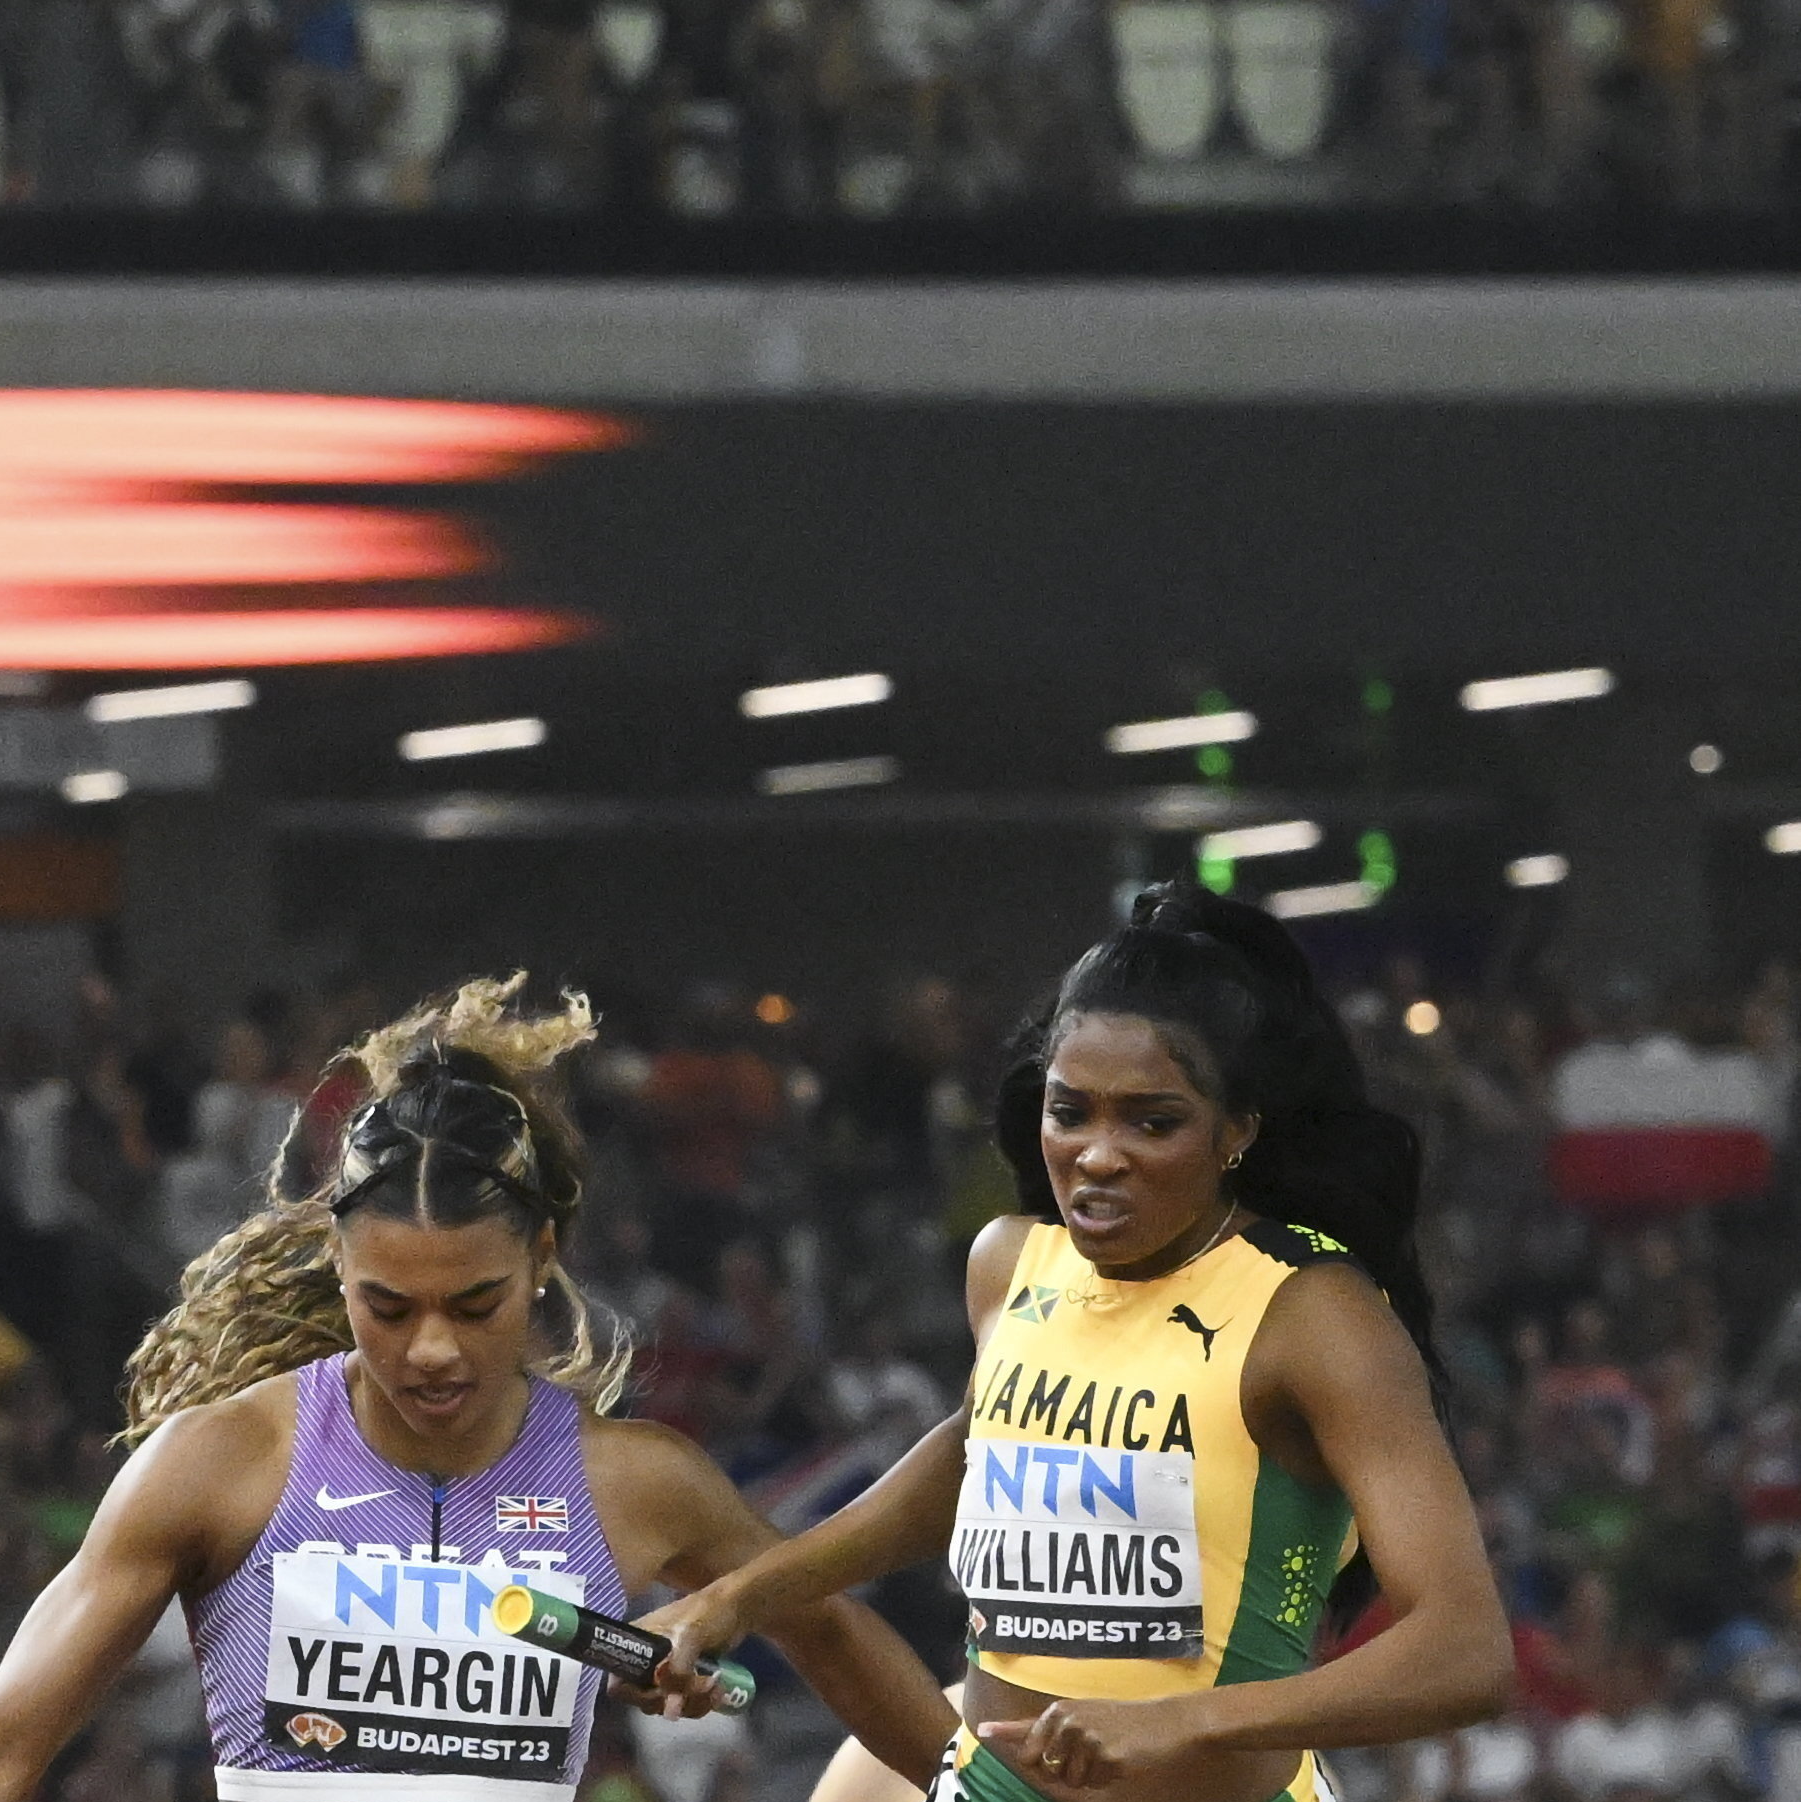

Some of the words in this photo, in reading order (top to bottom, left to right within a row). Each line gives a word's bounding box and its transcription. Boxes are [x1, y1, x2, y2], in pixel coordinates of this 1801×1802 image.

[975, 1360, 1196, 1460] JAMAICA
[985, 1445, 1138, 1521] NTN
[957, 1528, 1183, 1598] WILLIAMS
[287, 1636, 561, 1718] YEARGIN
